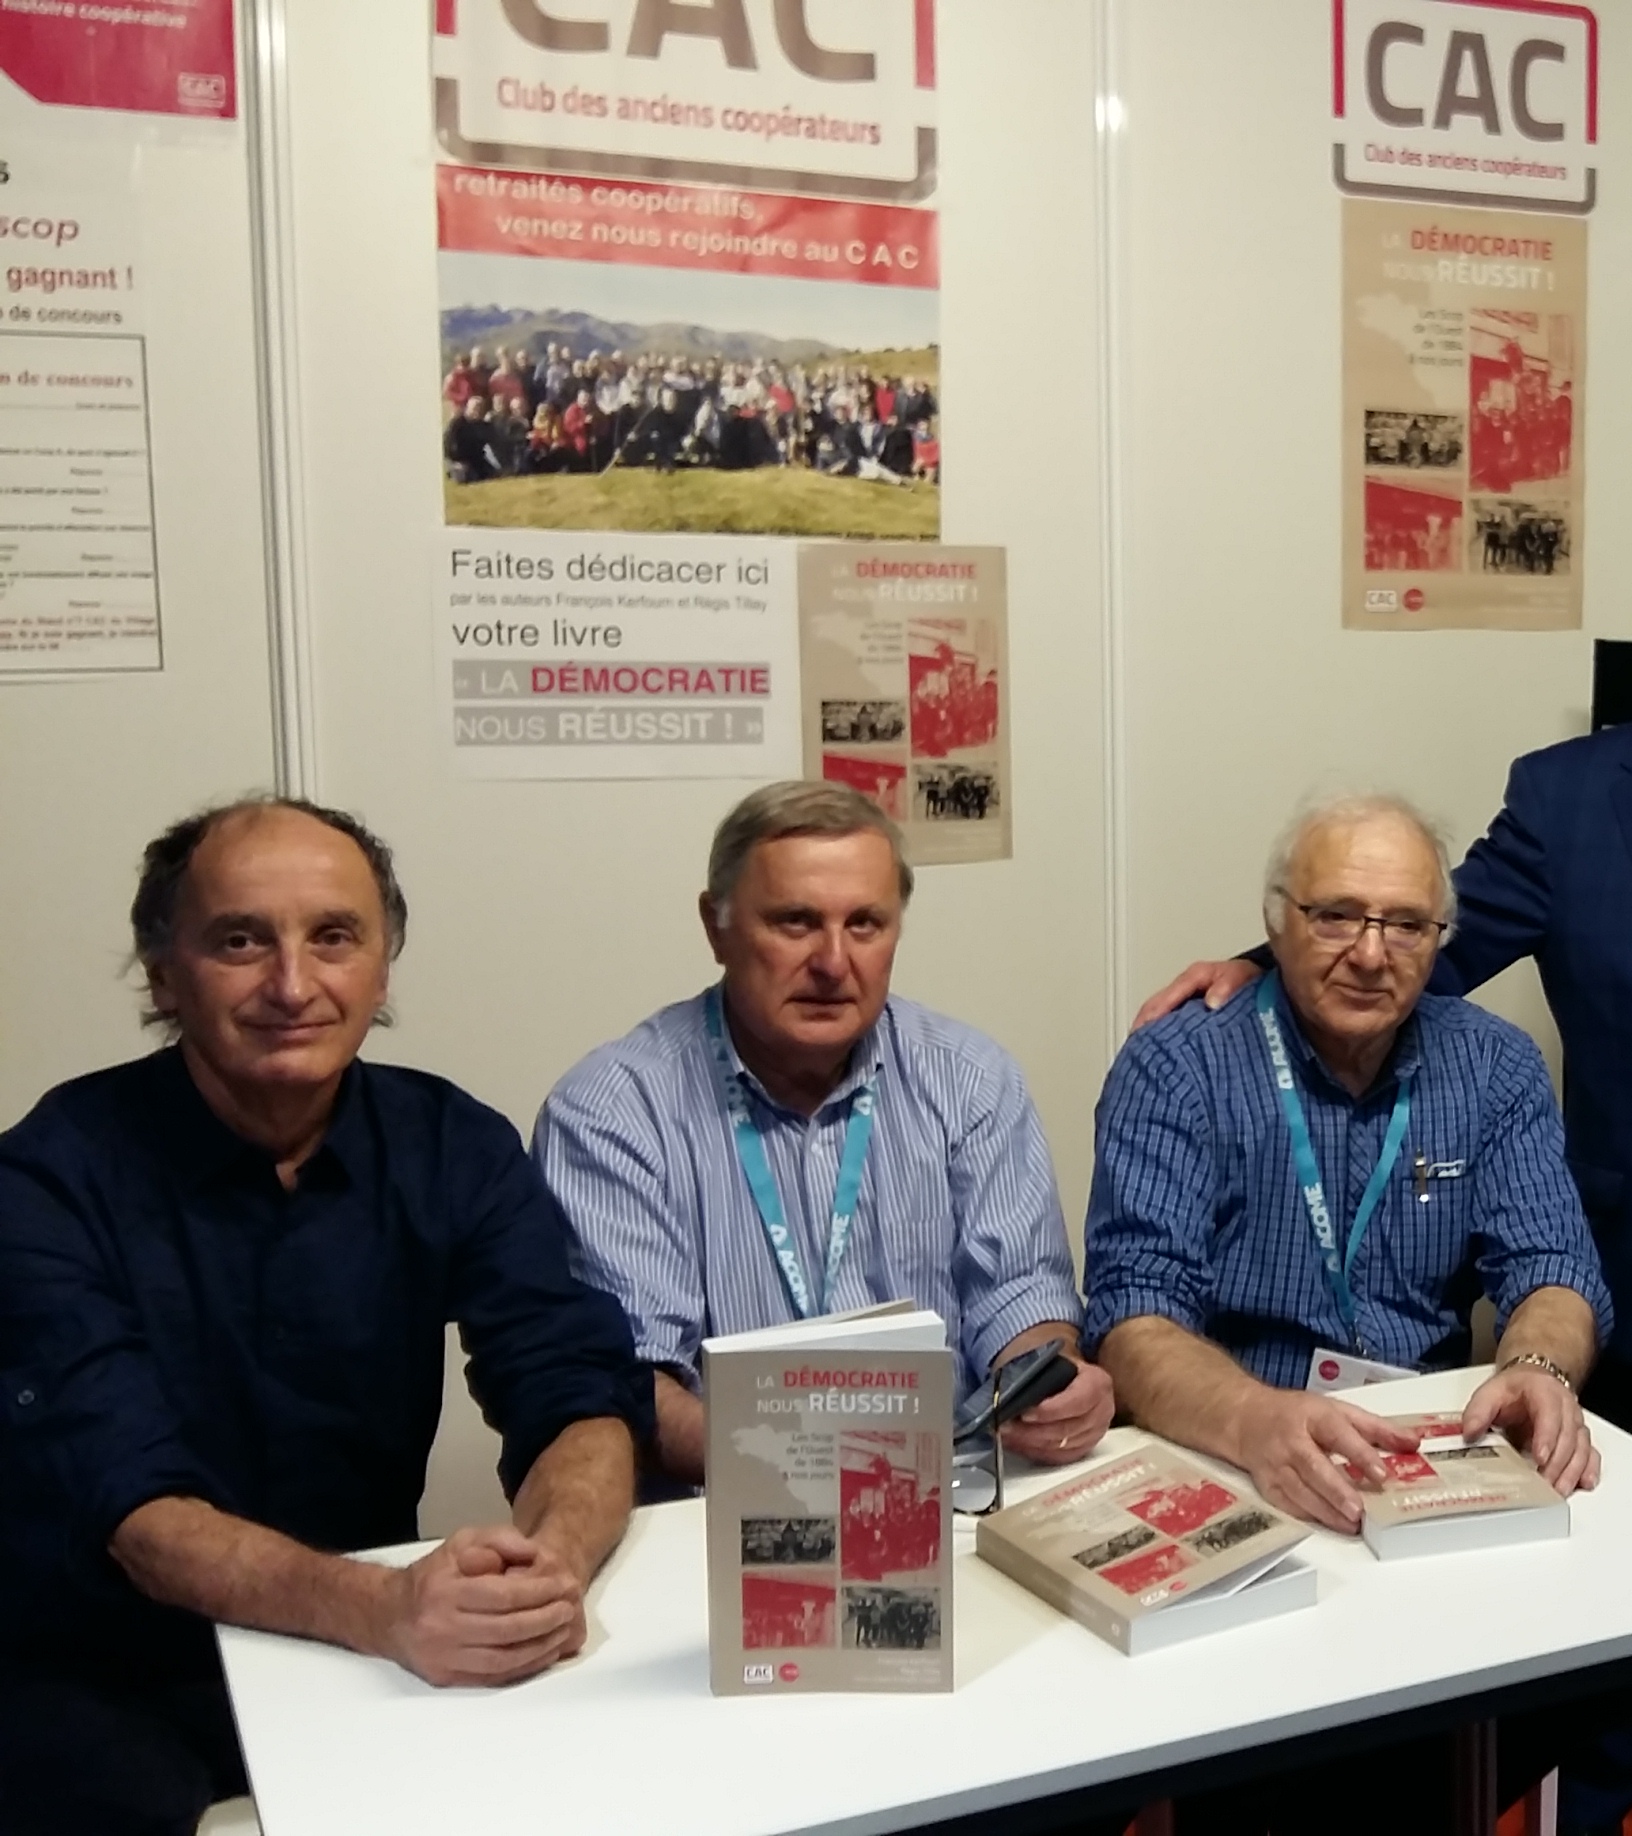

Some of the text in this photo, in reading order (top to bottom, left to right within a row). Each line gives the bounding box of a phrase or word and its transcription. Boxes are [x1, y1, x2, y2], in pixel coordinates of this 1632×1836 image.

[1364, 20, 1566, 143] CAC
[497, 77, 881, 146] Club des anciens coopérateurs
[1364, 143, 1567, 181] Club des anciens coopérateurs
[455, 172, 765, 225] retraités coopératifs,
[496, 213, 583, 241] venez
[594, 223, 661, 248] nous
[669, 222, 798, 260] rejoindre
[804, 240, 836, 264] au
[1411, 225, 1553, 261] DÉMOCRATIE
[7, 266, 118, 295] gagnant
[1437, 254, 1542, 290] RÉUSSIT
[450, 550, 770, 586] Faites dédicacer ici
[856, 557, 977, 579] DÉMOCRATIE
[452, 619, 623, 648] votre livre
[481, 670, 519, 693] LA
[531, 662, 771, 695] DÉMOCRATIE
[454, 713, 546, 740] NOUS
[558, 706, 715, 741] RÉUSSIT
[724, 713, 733, 740] !
[1304, 1182, 1337, 1250] ACOME
[757, 1366, 920, 1389] LA DÉMOCRATIE
[757, 1389, 920, 1414] NOUS RÉUSSIT !
